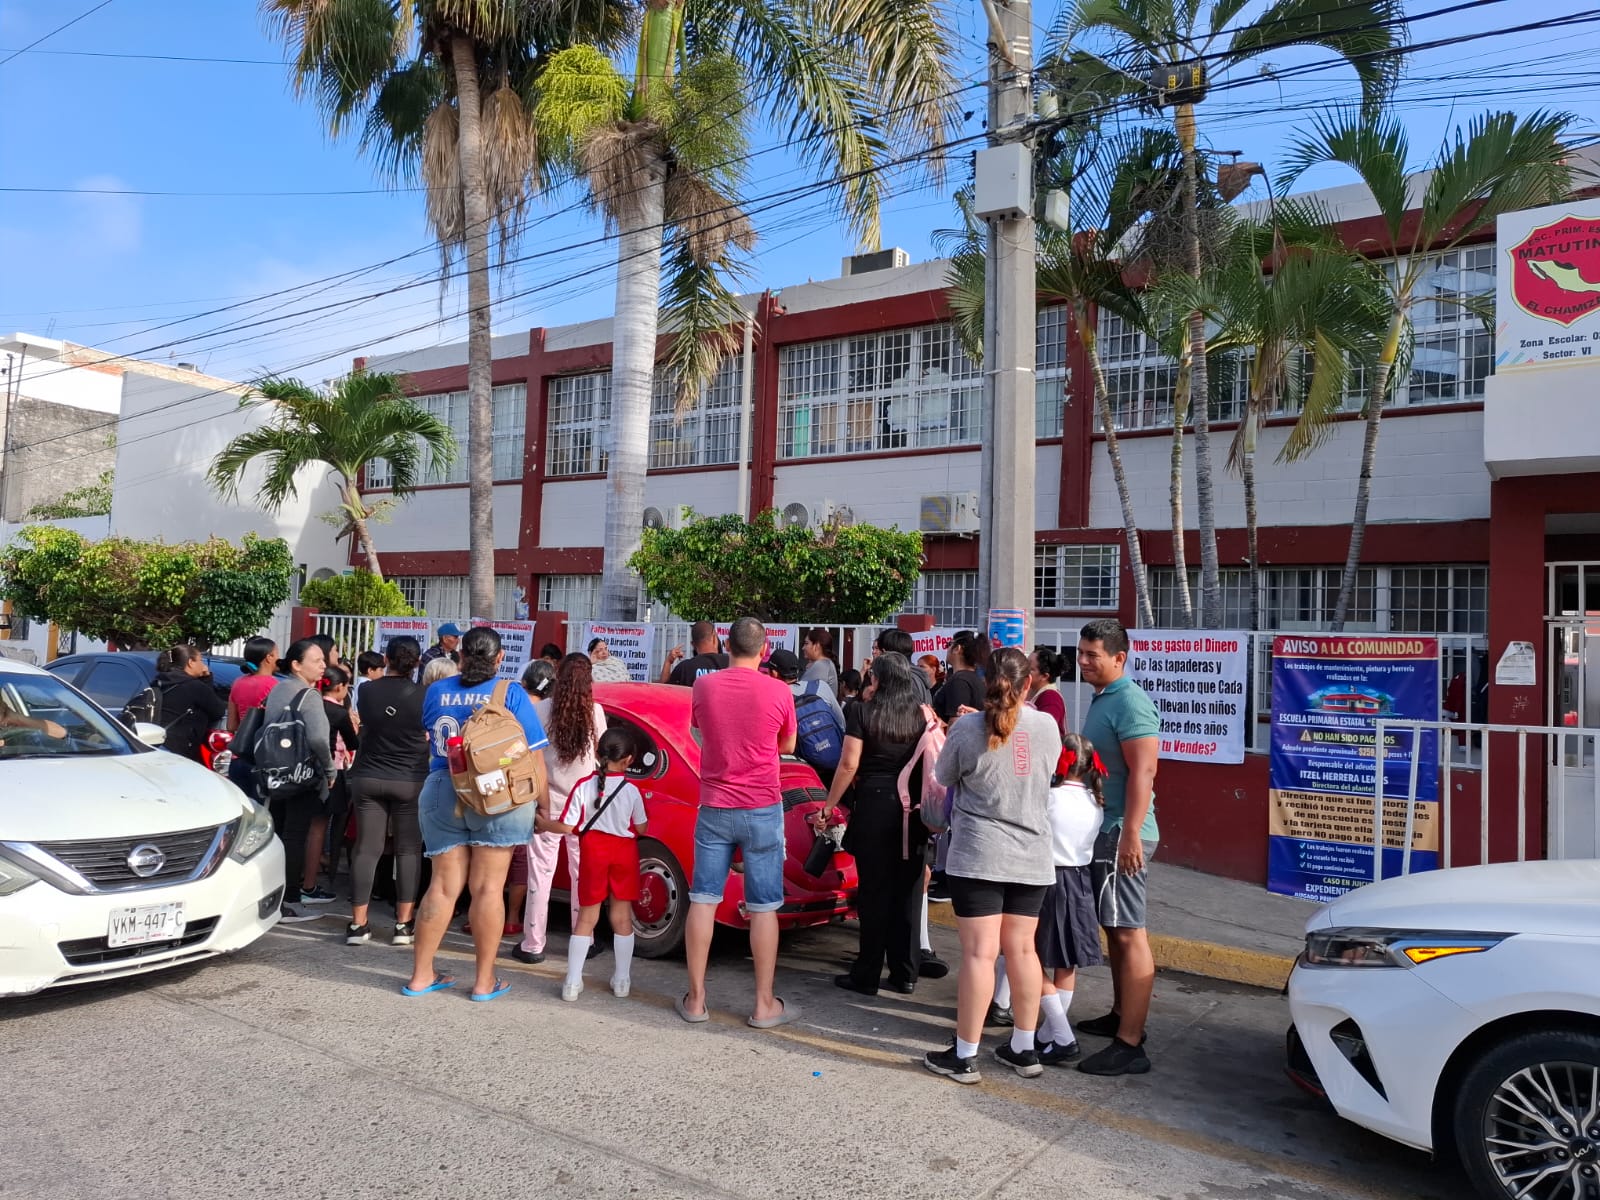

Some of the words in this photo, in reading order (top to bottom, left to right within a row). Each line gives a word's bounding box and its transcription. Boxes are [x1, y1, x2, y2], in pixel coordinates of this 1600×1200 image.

[1527, 234, 1552, 246] ESC.
[1555, 226, 1584, 237] PRIM.
[1526, 300, 1540, 312] EL
[1520, 339, 1544, 348] Zona
[1548, 334, 1587, 345] Escolar:
[1543, 349, 1576, 360] Sector:
[1581, 346, 1592, 356] VI
[766, 627, 787, 637] Dineros
[1133, 640, 1149, 653] que
[1151, 641, 1164, 652] se
[1165, 639, 1191, 654] gasto
[1194, 638, 1203, 652] el
[1205, 638, 1238, 653] Dinero
[1283, 639, 1318, 654] AVISO
[1321, 642, 1328, 654] A
[1331, 642, 1344, 655] LA
[1347, 640, 1424, 655] COMUNIDAD
[628, 650, 646, 659] Trato
[1134, 657, 1146, 671] De
[1148, 658, 1163, 672] las
[1165, 658, 1214, 674] tapaderas
[1216, 661, 1222, 674] y
[1293, 662, 1315, 671] trabajos
[1365, 665, 1386, 673] pintura
[1143, 678, 1154, 692] de
[1156, 678, 1195, 693] Plastico
[1197, 682, 1216, 695] que
[1218, 680, 1243, 695] Cada
[1160, 699, 1189, 714] llevan
[1191, 699, 1206, 715] los
[1209, 700, 1237, 716] niños
[1184, 720, 1202, 735] dos
[1204, 721, 1228, 736] años
[1279, 714, 1306, 723] ESCUELA
[1307, 715, 1339, 725] PRIMARIA
[1340, 716, 1365, 727] ESTATAL
[1313, 732, 1323, 741] NO
[1325, 733, 1340, 742] HAN
[1341, 733, 1359, 743] SIDO
[1162, 740, 1172, 752] tu
[1173, 739, 1217, 755] Vendes?
[1307, 759, 1343, 769] Responsable
[1344, 760, 1354, 769] del
[267, 762, 314, 789] Barbie
[1300, 770, 1321, 780] ITZEL
[1322, 772, 1360, 783] HERRERA
[1361, 773, 1389, 785] LEMS
[1312, 781, 1340, 791] Directora
[1340, 782, 1350, 792] del
[1351, 784, 1375, 793] plantel
[1280, 791, 1323, 802] Directora
[1325, 795, 1344, 804] que
[1356, 795, 1372, 806] fue
[1285, 800, 1318, 810] recibió
[1320, 803, 1335, 812] los
[1336, 805, 1375, 816] recurso
[1383, 809, 1430, 820] federles
[1294, 810, 1306, 818] de
[1307, 811, 1319, 820] mi
[1321, 813, 1359, 824] escuela
[1361, 817, 1373, 825] es
[1289, 819, 1298, 827] la
[1299, 820, 1331, 832] tarjeta
[1333, 824, 1351, 833] que
[1354, 824, 1373, 835] ella
[1290, 829, 1312, 837] pero
[1314, 830, 1327, 839] NO
[1328, 833, 1352, 842] pago
[1354, 835, 1361, 843] a
[1315, 844, 1335, 852] trabajos
[1323, 877, 1340, 885] CASO
[113, 910, 183, 935] VKM-447-C
